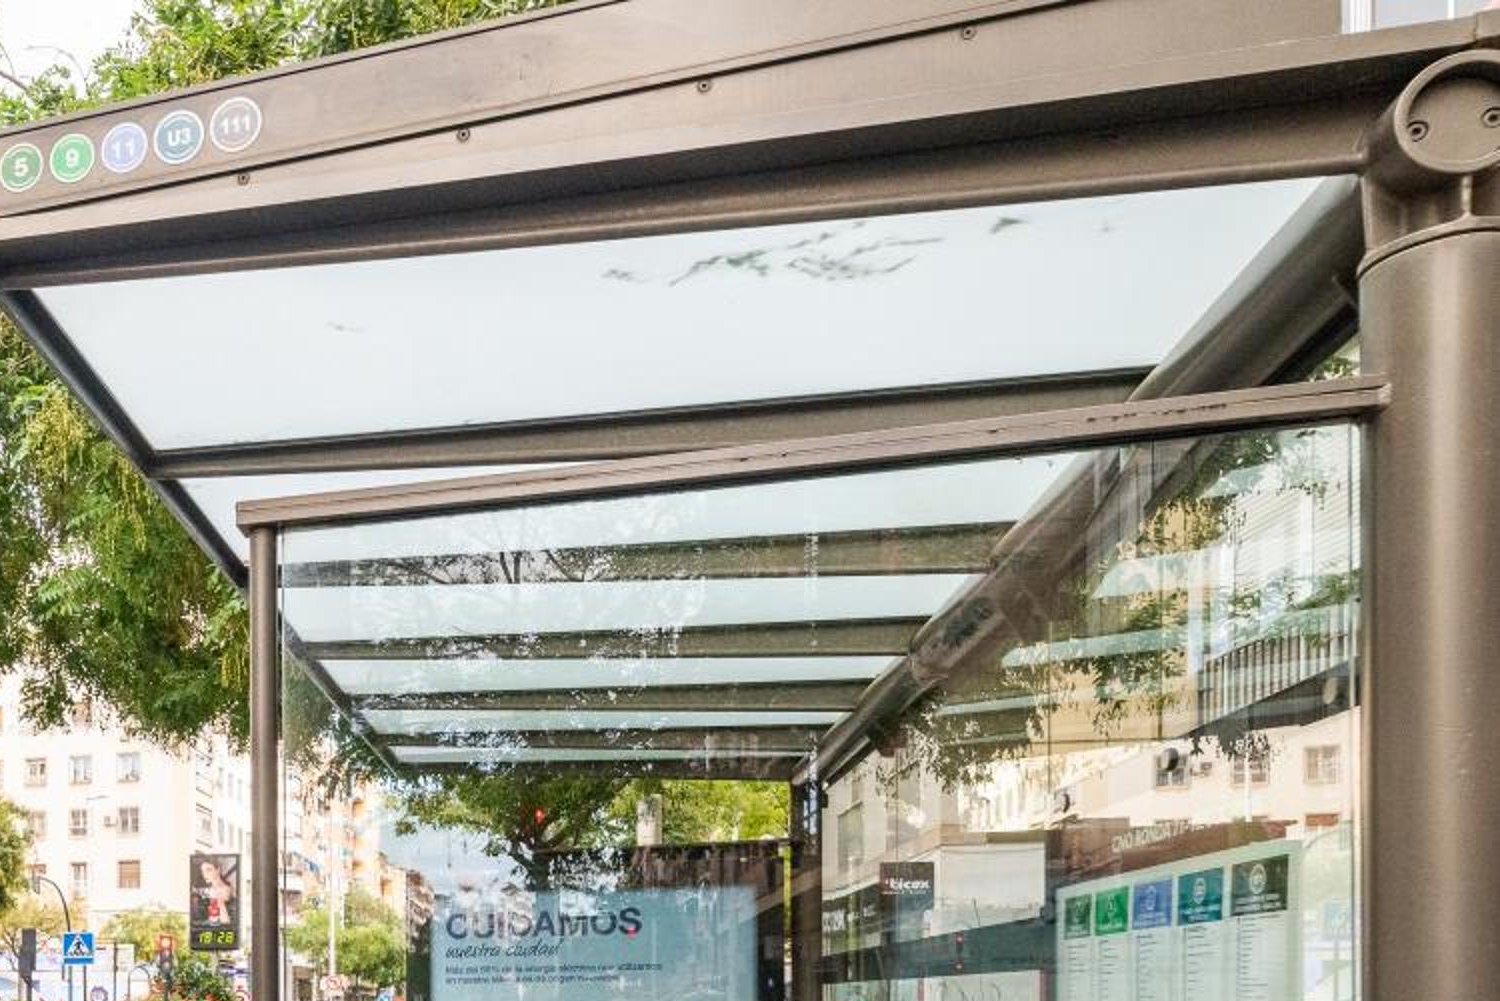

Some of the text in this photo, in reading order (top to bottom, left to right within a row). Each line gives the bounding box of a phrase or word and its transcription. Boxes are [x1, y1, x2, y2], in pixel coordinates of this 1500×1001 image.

[218, 114, 251, 136] 111
[167, 126, 192, 148] U3
[65, 151, 77, 169] 9
[111, 138, 136, 161] 11
[14, 157, 28, 178] 5
[445, 906, 643, 939] CUIDAMOS
